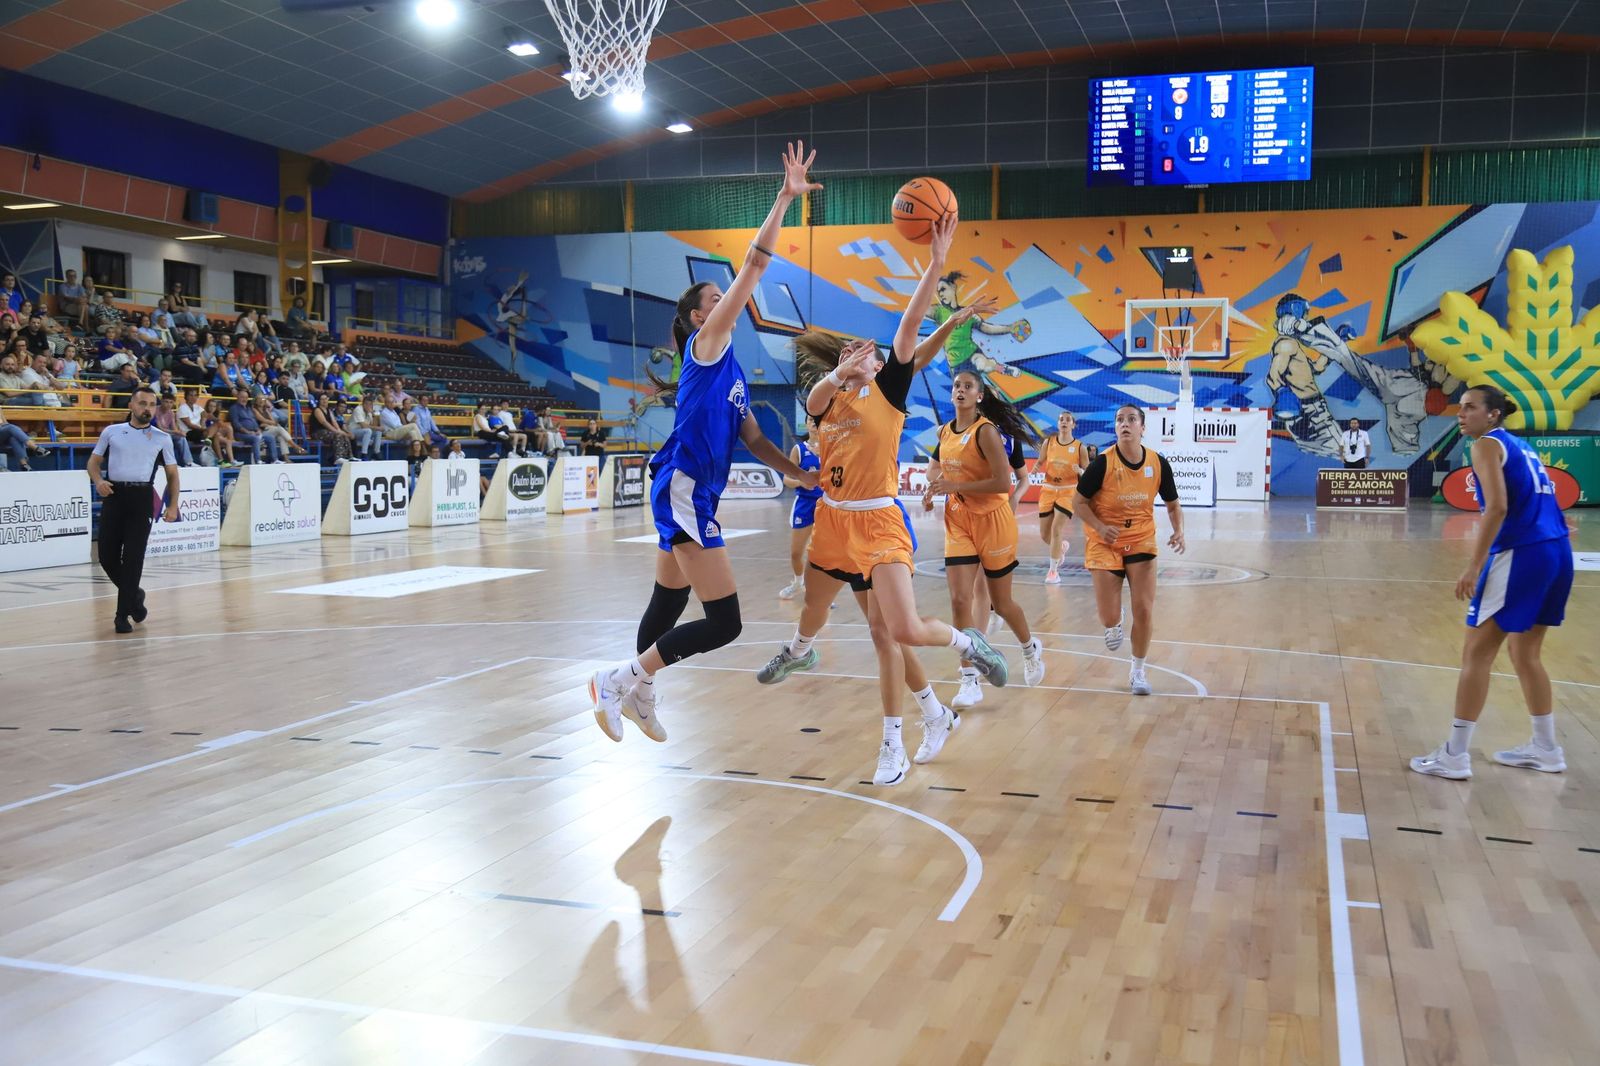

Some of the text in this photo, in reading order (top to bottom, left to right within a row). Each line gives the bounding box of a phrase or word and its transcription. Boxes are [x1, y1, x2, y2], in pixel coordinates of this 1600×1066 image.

[1174, 106, 1182, 120] 9
[1211, 104, 1225, 118] 30
[1195, 128, 1203, 136] 10
[1189, 136, 1209, 153] 1.9
[1224, 157, 1230, 168] 4
[1194, 419, 1236, 442] pinión
[1536, 439, 1580, 448] OURENSE
[1166, 454, 1209, 464] cobreros
[1172, 468, 1207, 479] obreros
[1320, 472, 1408, 480] TIERRA DEL VINO
[0, 497, 88, 525] ESTAURANTE
[254, 514, 316, 532] recoletas salud
